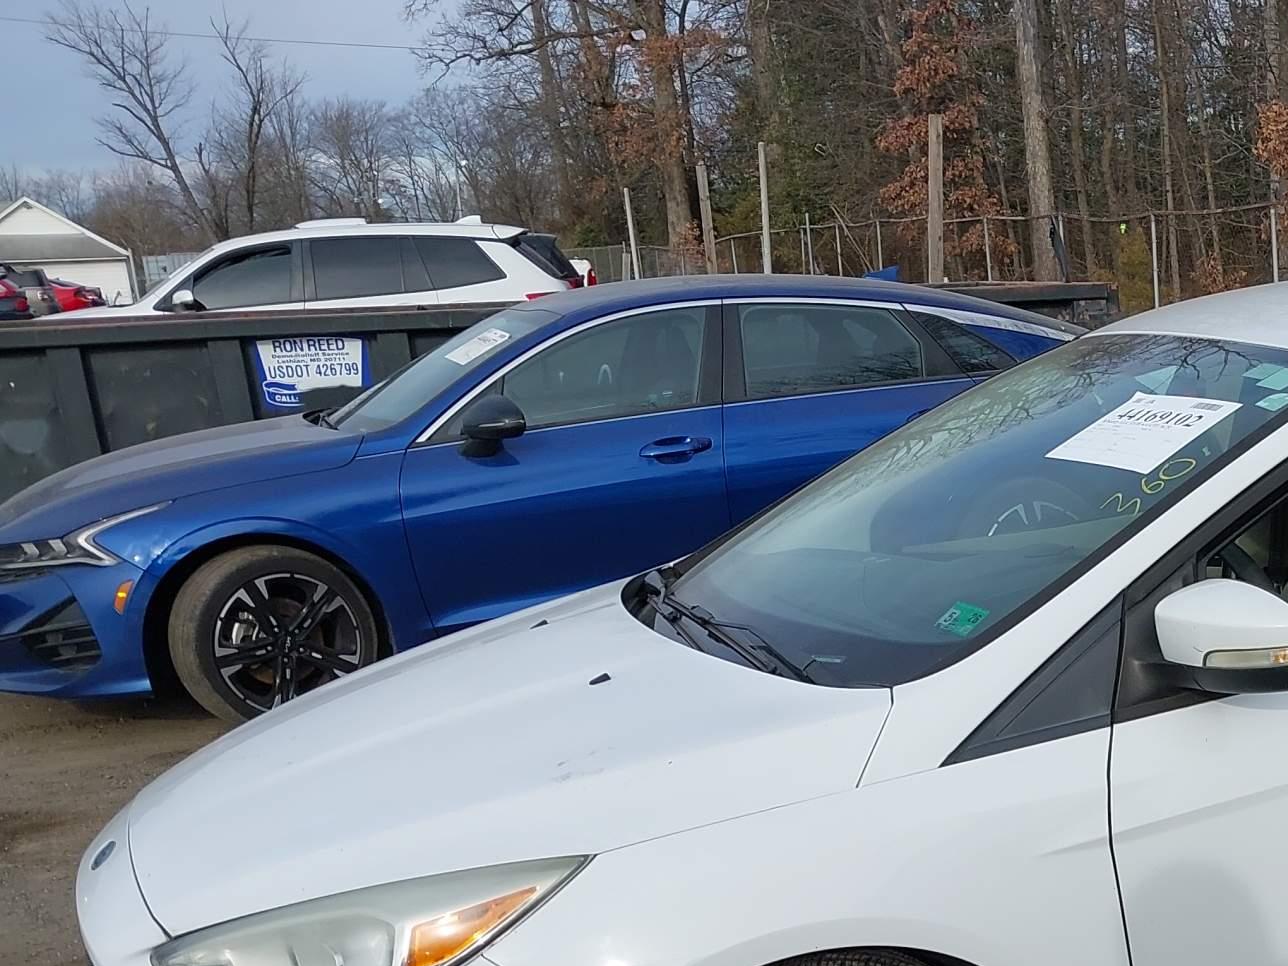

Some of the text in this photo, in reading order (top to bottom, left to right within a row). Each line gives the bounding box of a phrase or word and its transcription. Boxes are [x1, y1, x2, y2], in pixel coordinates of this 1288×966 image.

[271, 338, 345, 353] RON REED
[267, 362, 359, 379] USDOT 426799
[1117, 408, 1204, 427] 44169102
